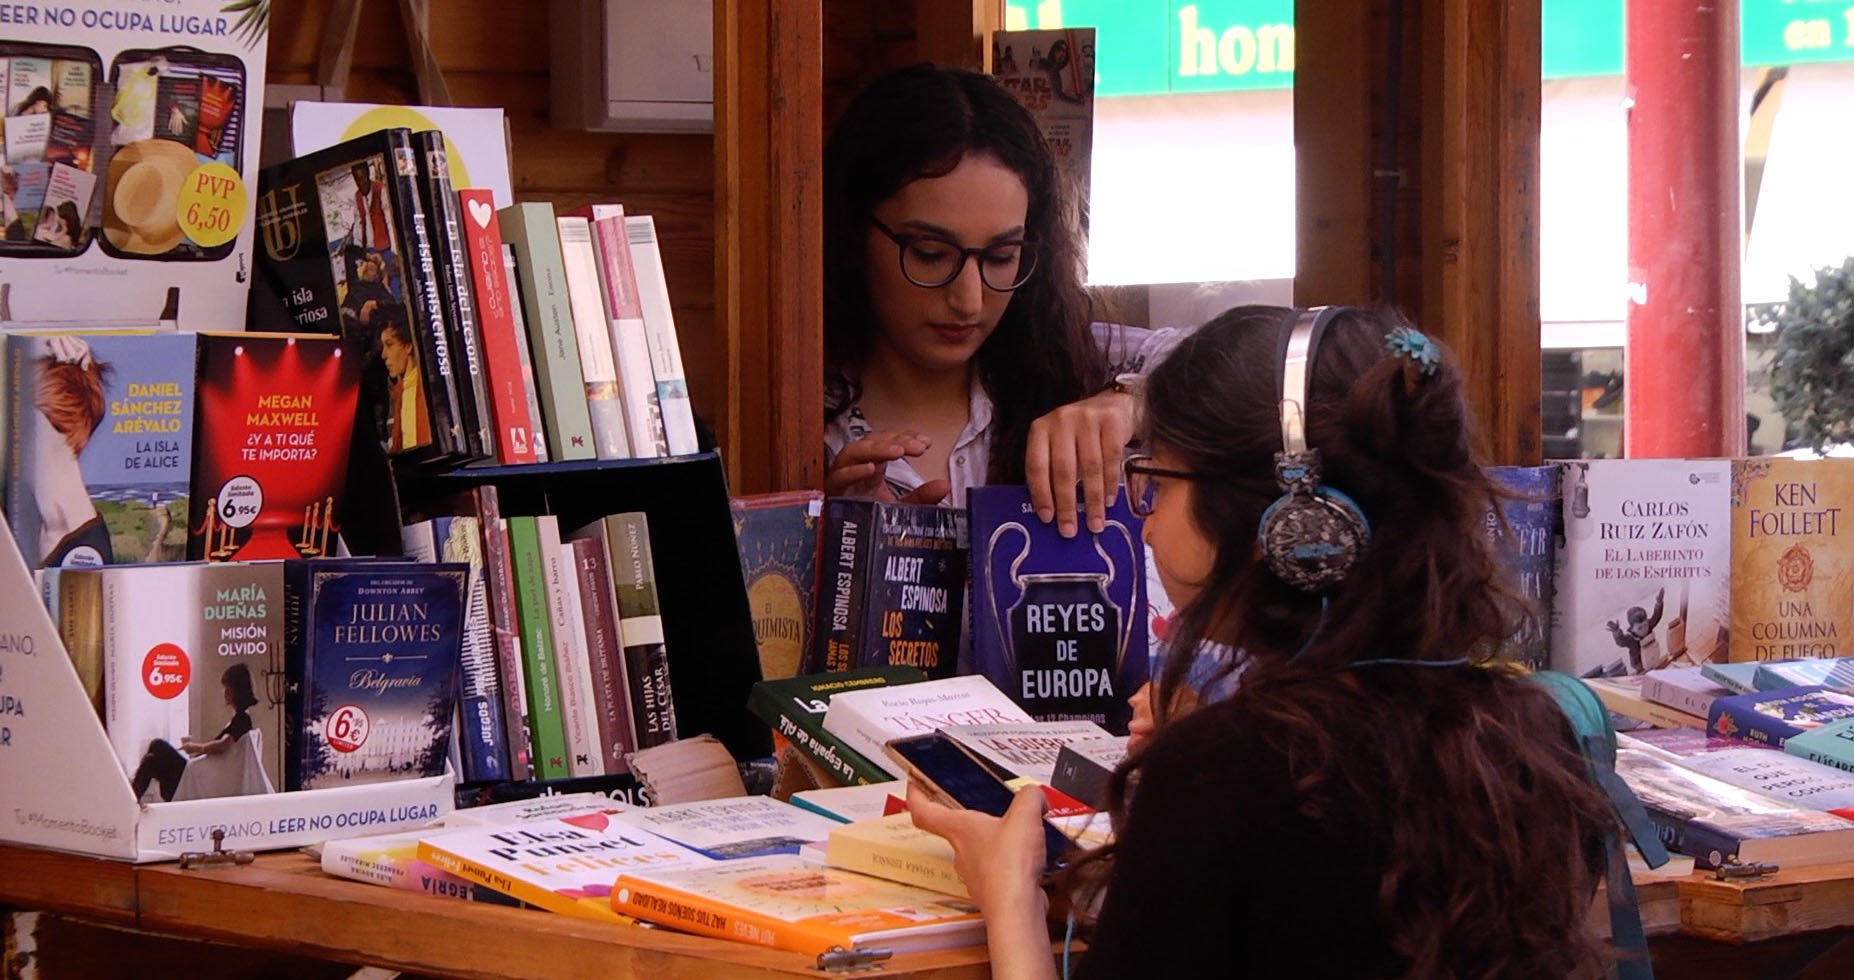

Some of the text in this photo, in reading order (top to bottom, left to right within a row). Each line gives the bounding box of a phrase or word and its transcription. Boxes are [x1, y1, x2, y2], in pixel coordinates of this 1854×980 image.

[0, 4, 227, 36] EER NO OCUPA LUGAR
[195, 173, 236, 199] PVP
[187, 203, 231, 232] 6,50
[292, 287, 314, 306] isla
[413, 213, 450, 376] La isla misteriosa
[457, 286, 472, 313] del
[294, 305, 329, 326] riosa
[551, 303, 563, 336] Austen
[463, 319, 479, 375] tesoro
[558, 334, 567, 361] Jane
[128, 382, 183, 397] DANIEL
[258, 395, 313, 409] MEGAN
[111, 398, 182, 416] SÁNCHEZ
[246, 412, 320, 427] MAXWELL
[112, 416, 182, 434] ARÉVALO
[136, 441, 180, 454] LA ISLA
[247, 430, 315, 447] ¿Y A TI QUÉ
[125, 455, 180, 470] DE ALICE
[242, 448, 319, 462] TE IMPORTA?
[1775, 483, 1817, 507] KEN
[1750, 508, 1841, 538] FOLLETT
[551, 557, 560, 586] barro
[582, 557, 598, 571] 13
[631, 559, 645, 591] PABLO
[832, 520, 857, 632] ALBERT ESPINOSA
[884, 555, 924, 583] ALBERT
[217, 583, 266, 602] MARÍA
[901, 585, 948, 614] ESPINOSA
[204, 602, 267, 620] DUEÑAS
[351, 603, 429, 625] JULIAN
[553, 595, 565, 627] Cañas
[1027, 603, 1105, 633] REYES
[1778, 601, 1813, 618] UNA
[221, 623, 267, 640] MISIÓN
[334, 623, 442, 644] FELLOWES
[882, 611, 904, 637] LOS
[1751, 621, 1838, 641] COLUMNA
[218, 641, 267, 656] OLVIDO
[888, 639, 940, 668] SECRETOS
[1056, 640, 1078, 662] DE
[348, 668, 423, 696] Belgravia
[1022, 668, 1114, 699] EUROPA
[640, 674, 660, 734] LAS HIJAS
[653, 666, 671, 732] DEL CÉSAR
[478, 701, 494, 746] JUEGOS
[797, 728, 809, 744] de
[808, 738, 843, 771] España
[978, 739, 1010, 751] LA
[842, 762, 855, 781] La
[158, 827, 195, 845] ESTE
[269, 817, 306, 835] LEER
[309, 815, 332, 832] NO
[336, 808, 387, 829] OCUPA
[390, 803, 438, 824] LUGAR
[488, 835, 646, 862] Punset
[489, 829, 586, 847] Elsa
[421, 875, 474, 900] LEGRÍA
[462, 862, 495, 888] Punset
[496, 877, 512, 893] Elsa
[631, 892, 727, 930] HAZ TUS SUEÑOS REALIDAD
